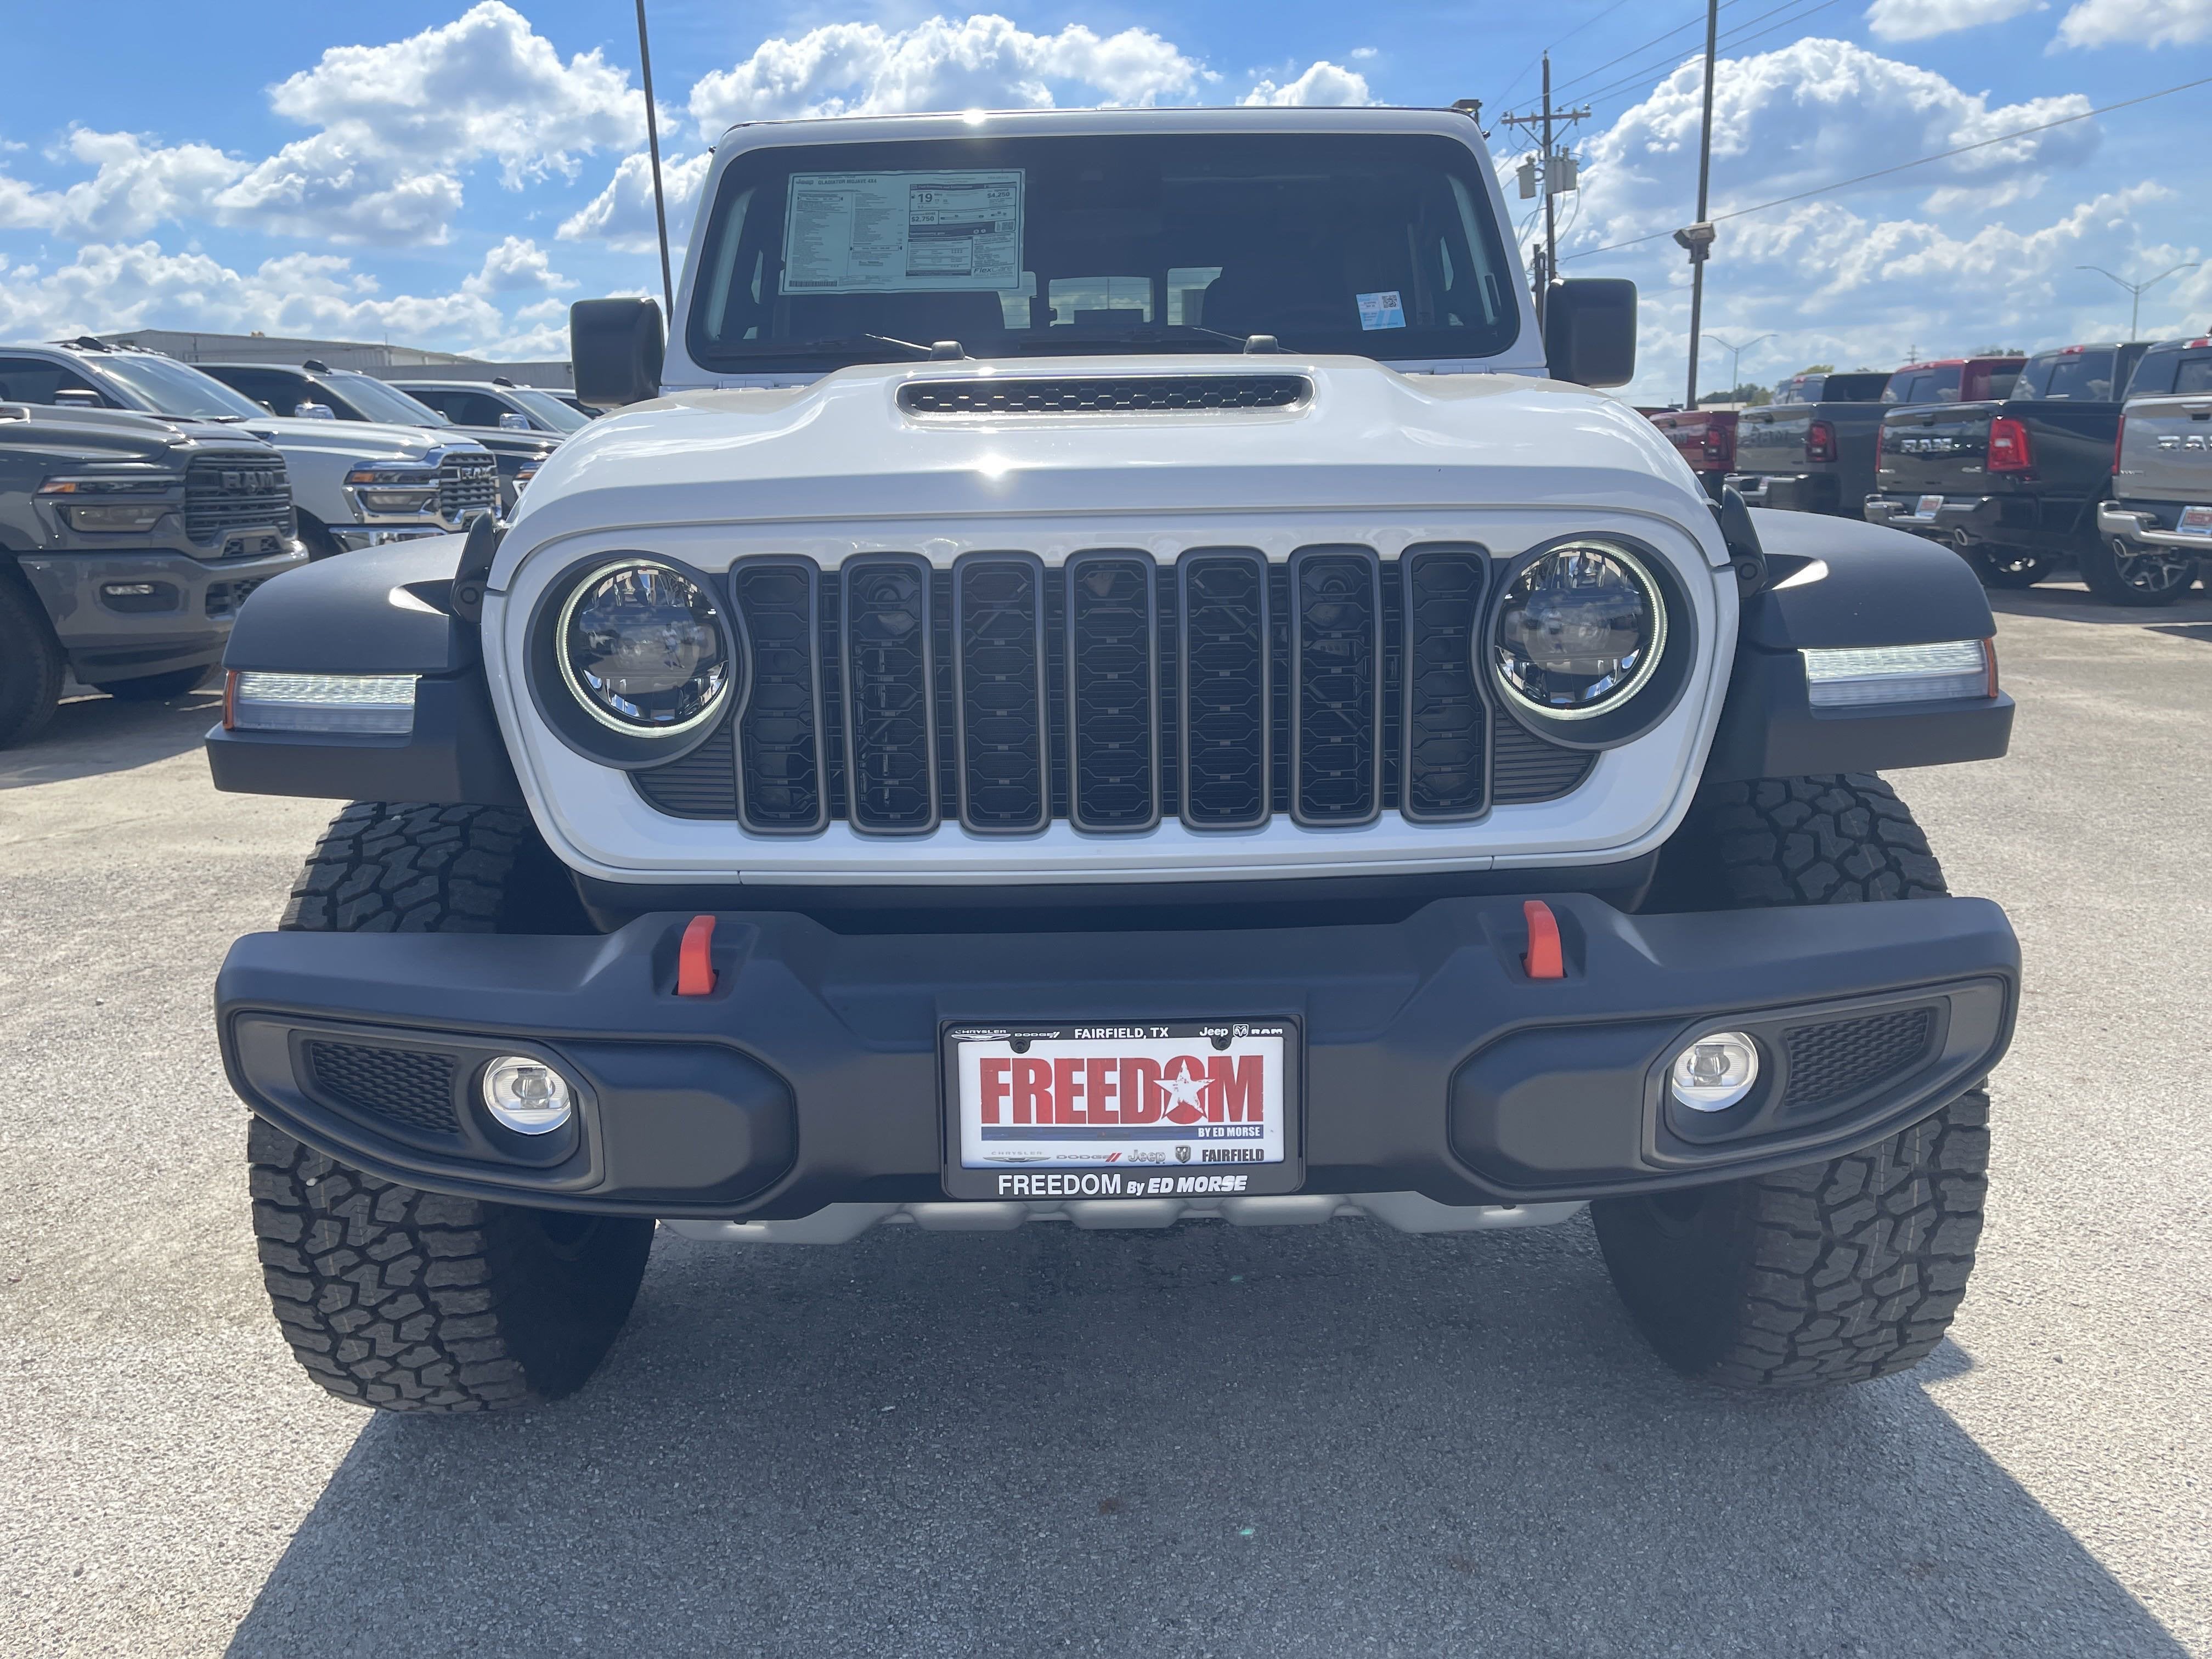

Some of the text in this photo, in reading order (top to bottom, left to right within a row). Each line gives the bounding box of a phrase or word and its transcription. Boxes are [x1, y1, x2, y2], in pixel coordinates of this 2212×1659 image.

[918, 193, 933, 203] 19
[1900, 438, 1953, 453] RAM
[2157, 436, 2212, 452] RA
[222, 471, 273, 488] RAM
[1074, 1027, 1169, 1039] FAIRFIELD, TX
[1199, 1026, 1228, 1036] Jeep
[980, 1055, 1263, 1124] FREEDOM
[1198, 1126, 1260, 1137] BY ED MORSE
[1127, 1150, 1166, 1164] Jeep
[1202, 1149, 1265, 1162] FAIRFIELD
[998, 1173, 1248, 1196] FREEDOM By ED MORSE
